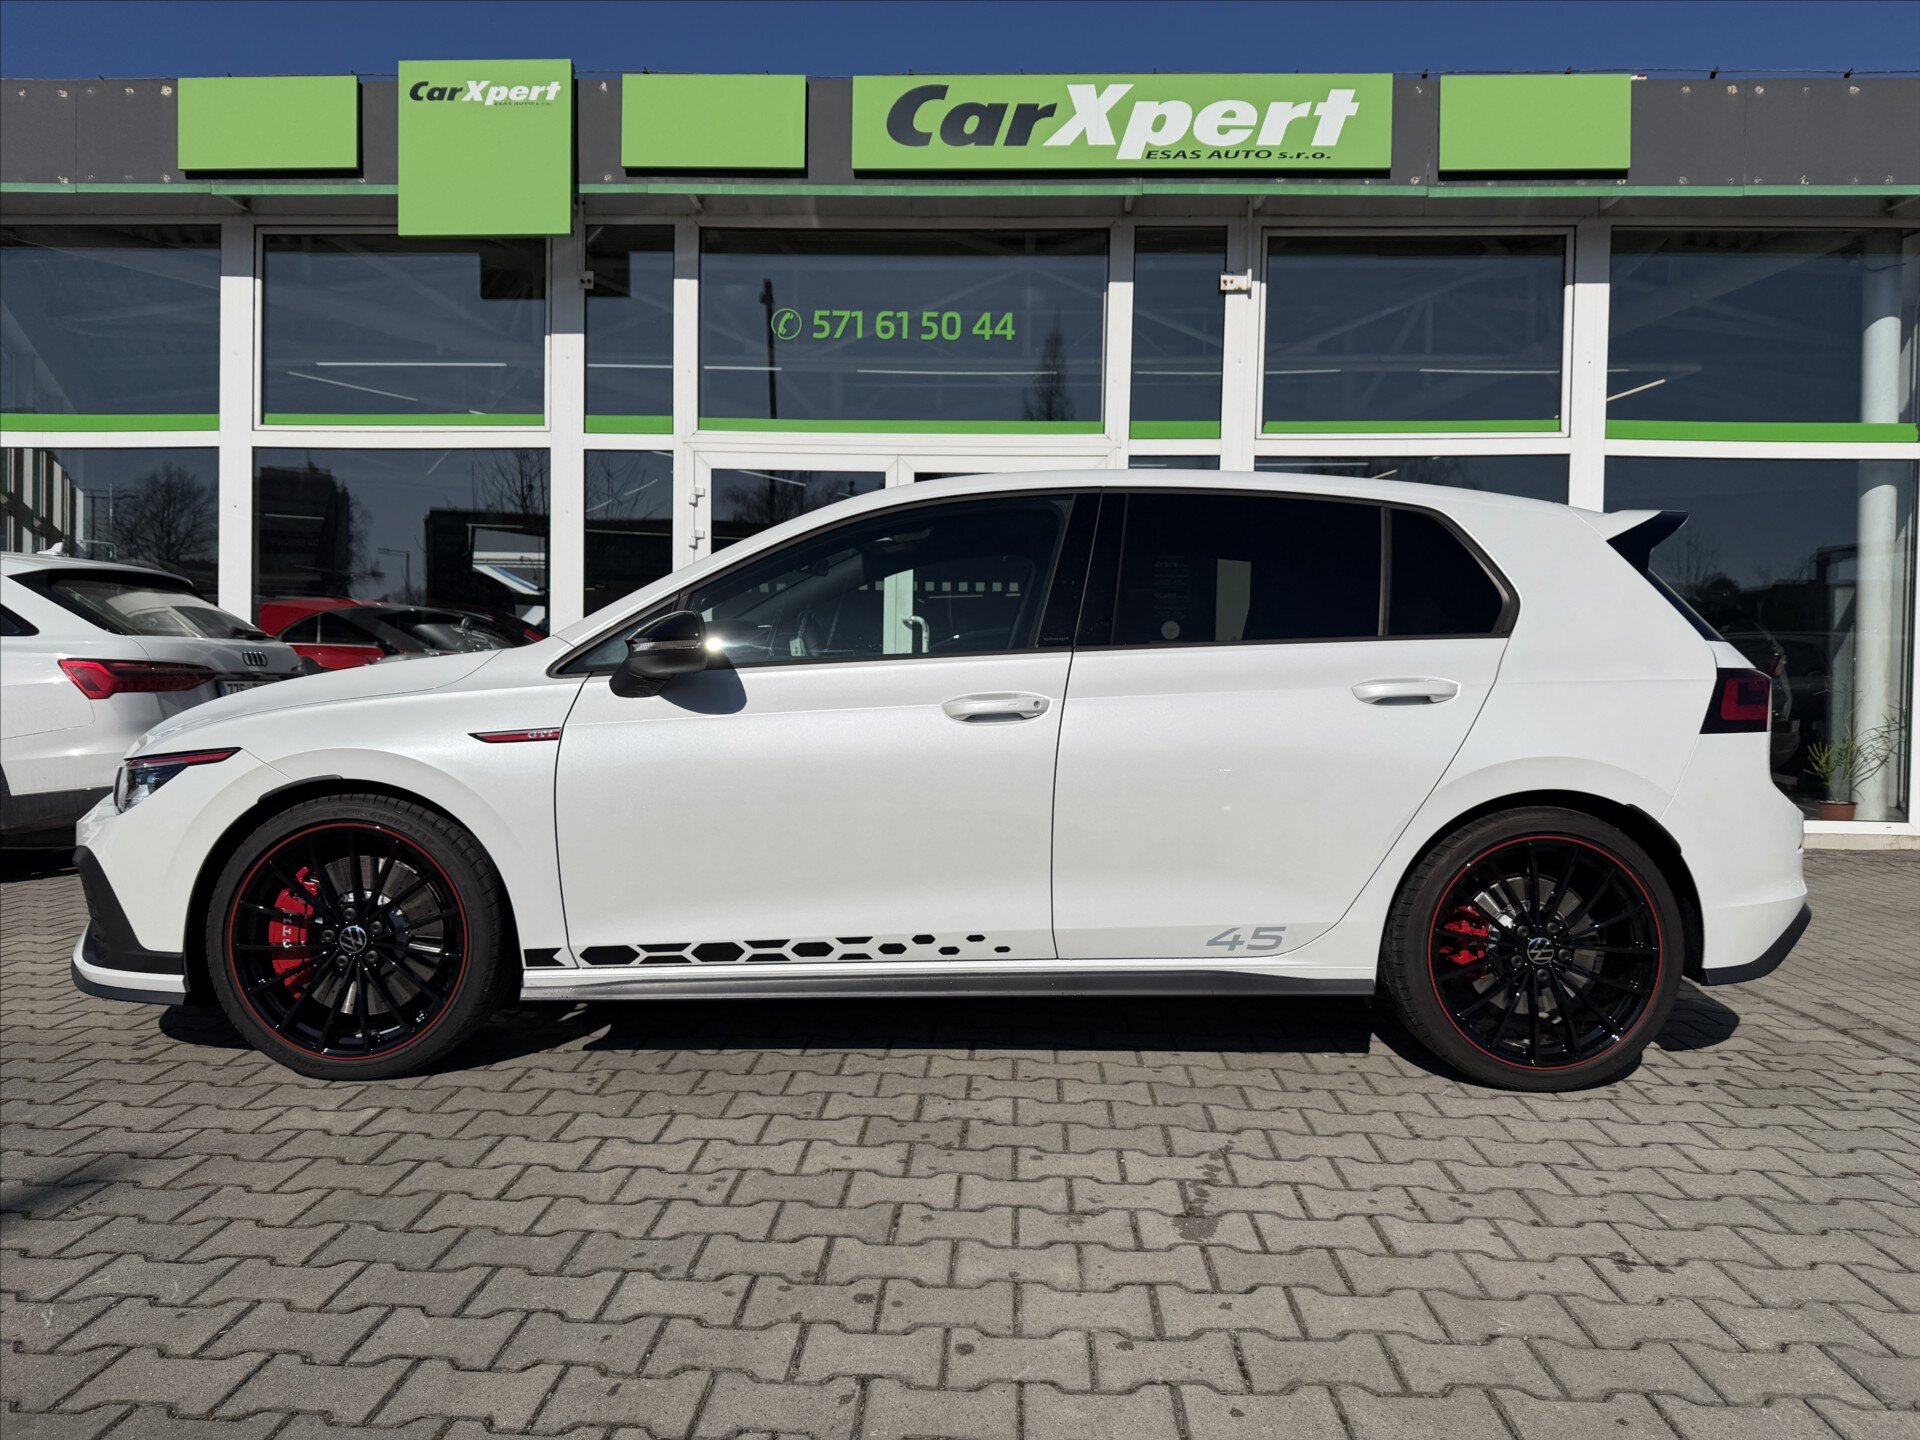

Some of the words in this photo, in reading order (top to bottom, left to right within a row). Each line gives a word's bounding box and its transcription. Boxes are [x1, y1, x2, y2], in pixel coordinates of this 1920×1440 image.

[409, 80, 561, 106] CarXpert
[886, 83, 1361, 160] CarXpert
[1145, 149, 1202, 160] ESAS
[1206, 149, 1273, 159] AUTO
[1277, 150, 1332, 160] s.r.o.
[812, 309, 864, 339] 571
[875, 310, 909, 340] 61
[920, 311, 962, 341] 50
[972, 312, 1016, 341] 44
[1205, 926, 1287, 952] 45
